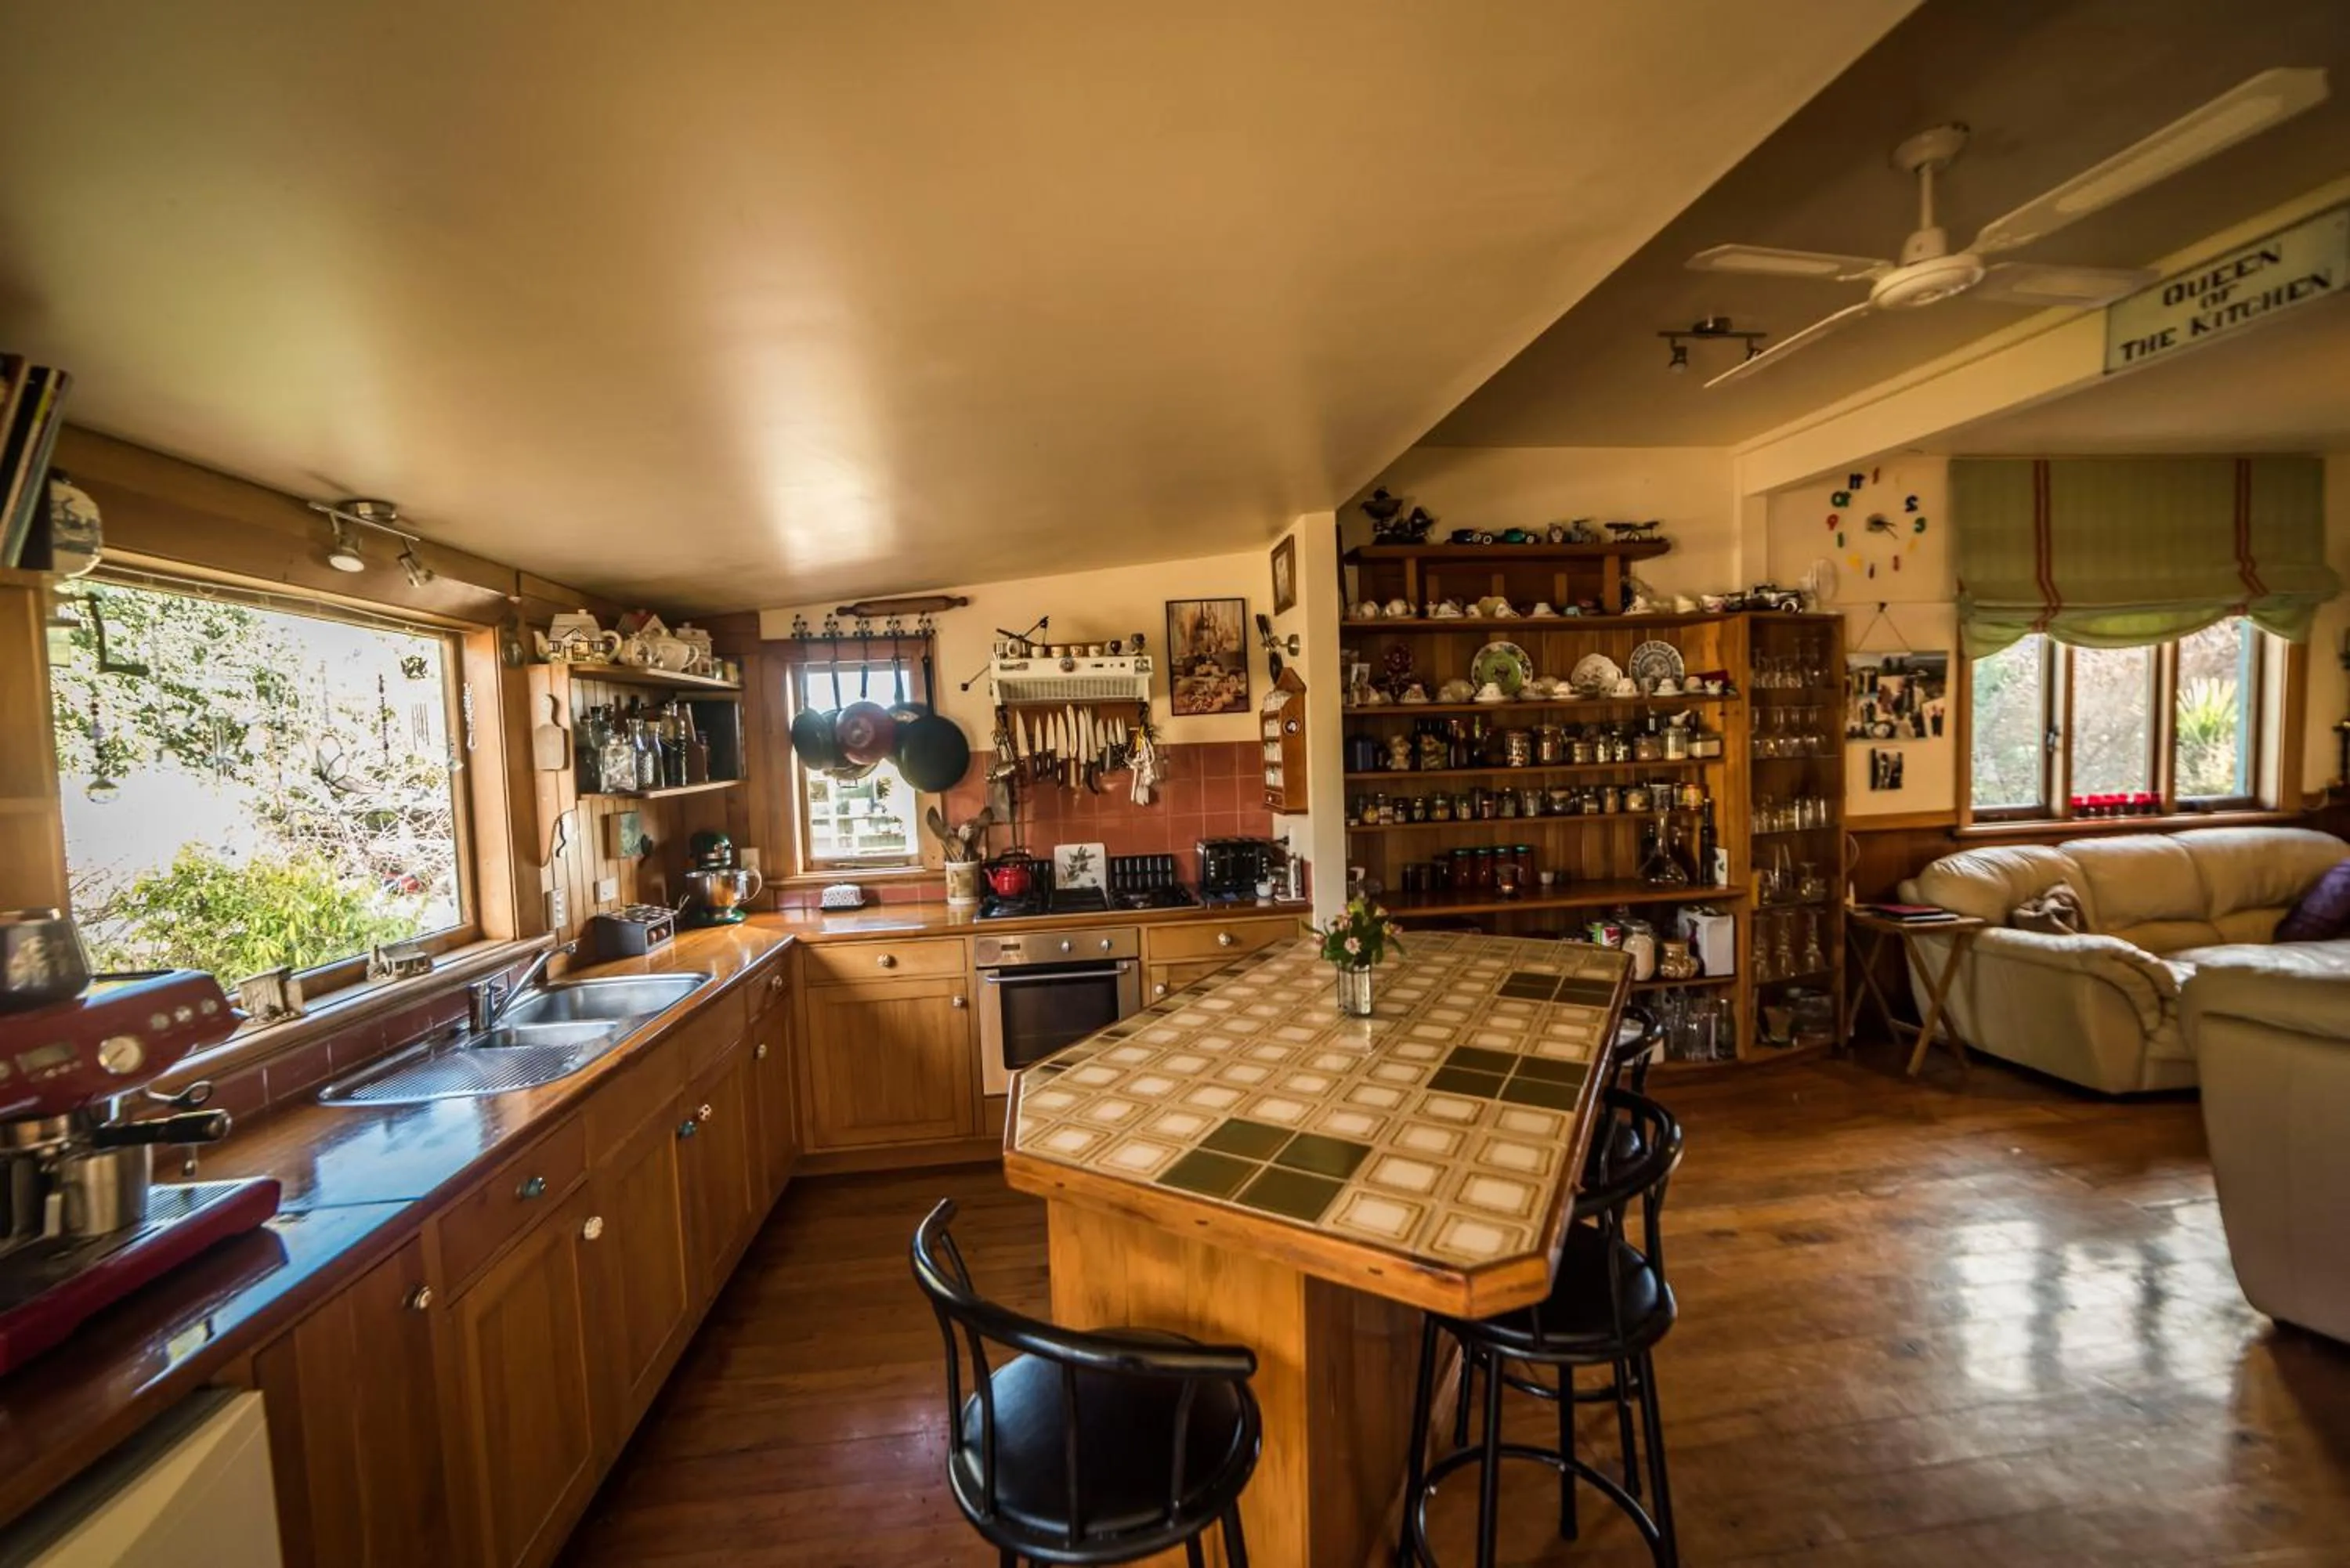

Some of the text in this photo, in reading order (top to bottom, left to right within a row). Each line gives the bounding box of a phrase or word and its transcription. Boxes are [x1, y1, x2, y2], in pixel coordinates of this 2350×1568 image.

[2163, 243, 2281, 306] QUEEN
[2118, 269, 2332, 361] THE KITCHEN
